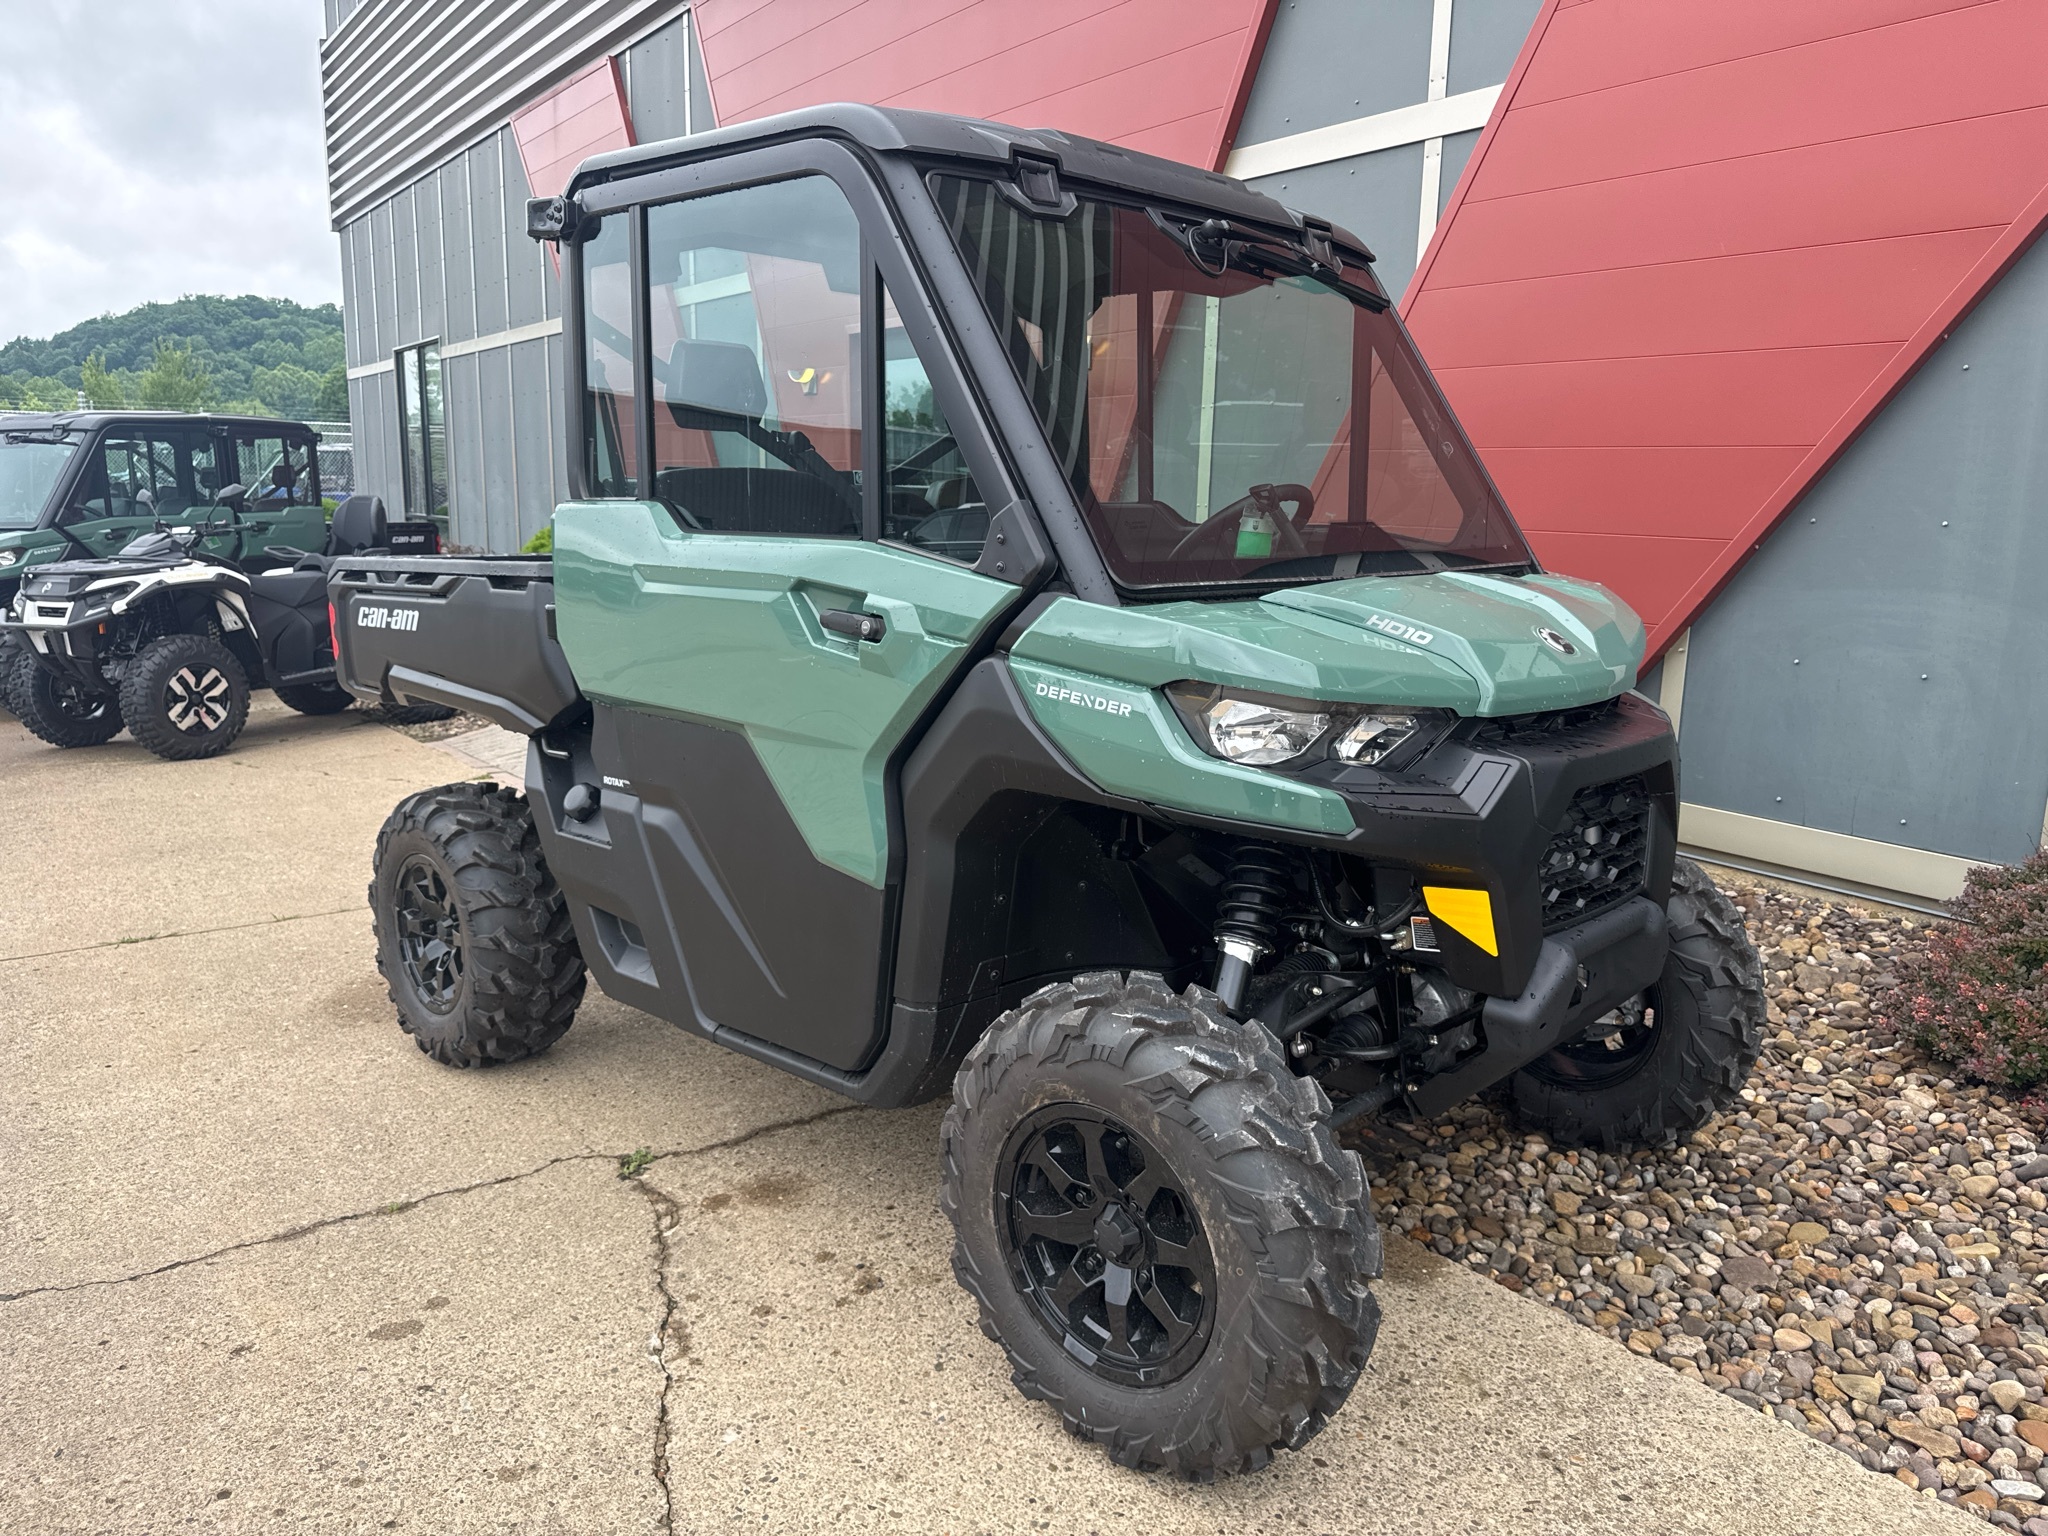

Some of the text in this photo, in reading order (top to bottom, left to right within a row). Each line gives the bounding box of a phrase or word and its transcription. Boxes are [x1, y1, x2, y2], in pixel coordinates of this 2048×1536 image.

[391, 535, 425, 544] can-am
[357, 606, 420, 632] can-am
[1365, 614, 1434, 645] HD10
[1035, 682, 1132, 717] DEFENDER
[603, 775, 624, 787] ROTAX
